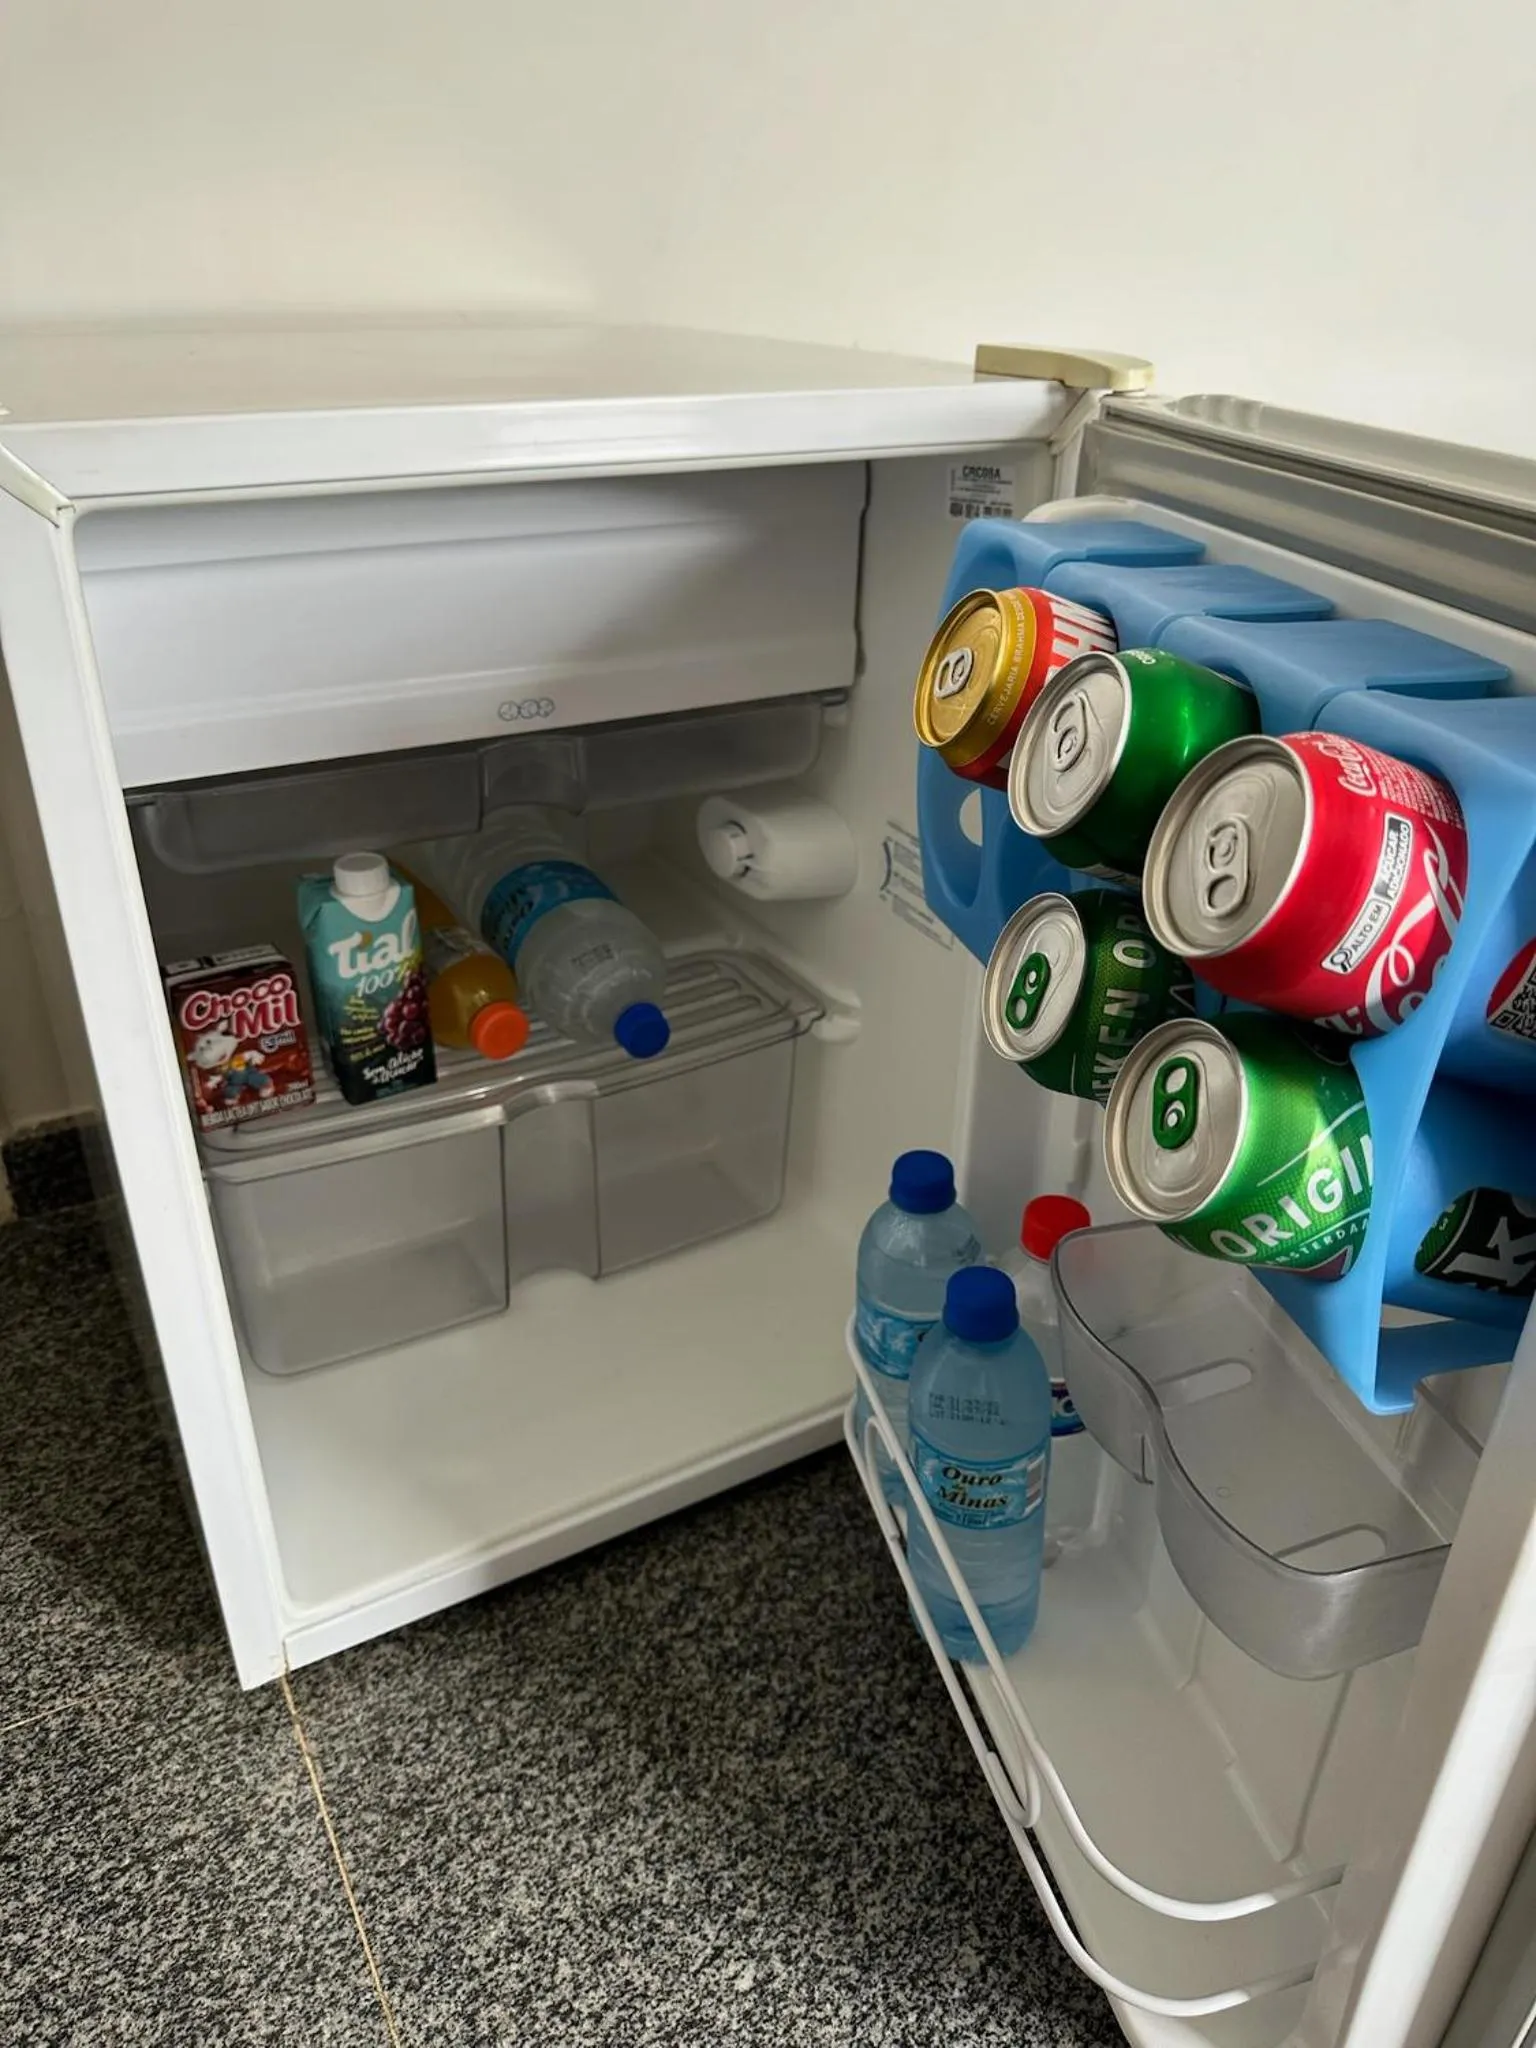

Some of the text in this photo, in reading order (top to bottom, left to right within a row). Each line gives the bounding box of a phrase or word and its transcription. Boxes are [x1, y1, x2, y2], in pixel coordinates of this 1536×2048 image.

[987, 667, 1019, 726] CERVEJARIA
[328, 907, 417, 980] Tial
[1352, 904, 1383, 952] ALTO EM
[181, 974, 292, 1031] Choco
[232, 990, 300, 1041] Mil
[936, 1484, 1009, 1510] Minas
[942, 1465, 1003, 1487] Ouro
